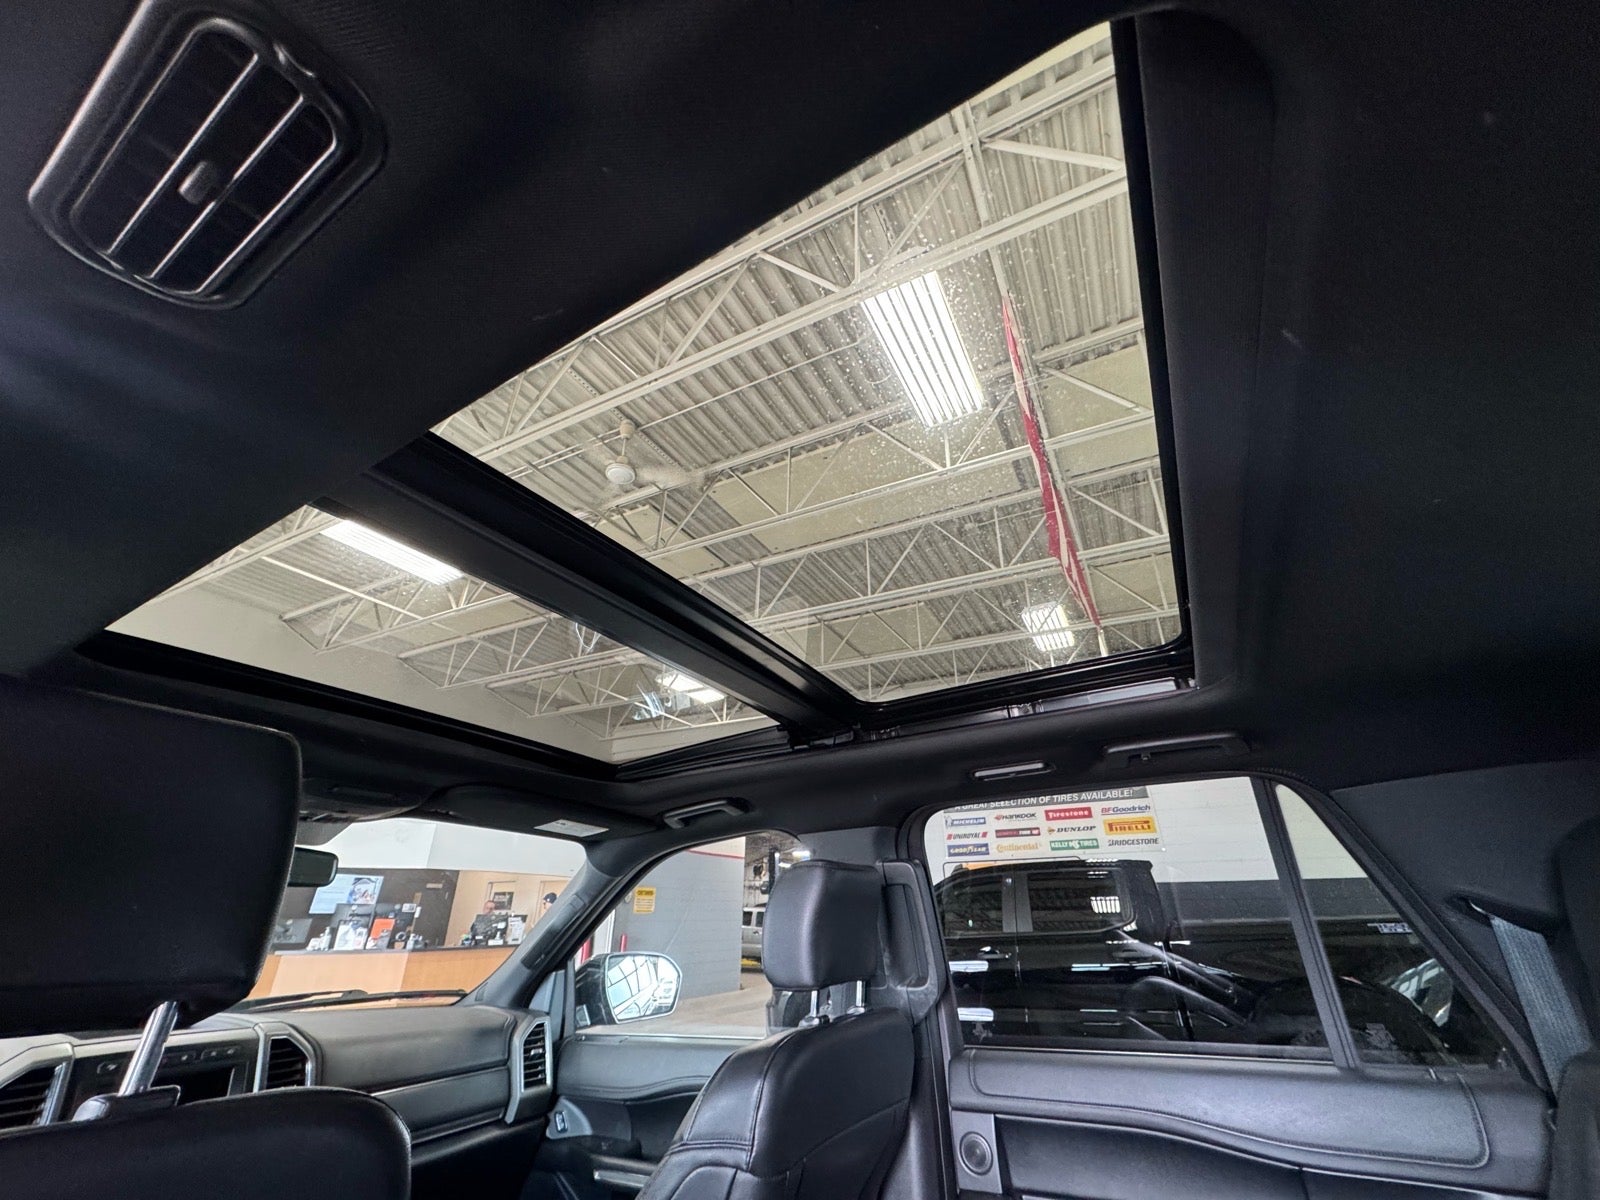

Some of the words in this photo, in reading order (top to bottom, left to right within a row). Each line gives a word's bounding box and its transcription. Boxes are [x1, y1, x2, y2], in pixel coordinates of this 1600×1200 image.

[990, 798, 1036, 807] SELECTION
[1053, 794, 1079, 803] TIRES
[1081, 790, 1132, 801] AVAILABLE!
[1048, 810, 1089, 818] Firestone
[1101, 805, 1151, 814] BFGoodrich
[1108, 821, 1151, 832] PIRELLI
[1080, 839, 1098, 847] TIRES
[1108, 838, 1159, 847] BRIDGESTONE
